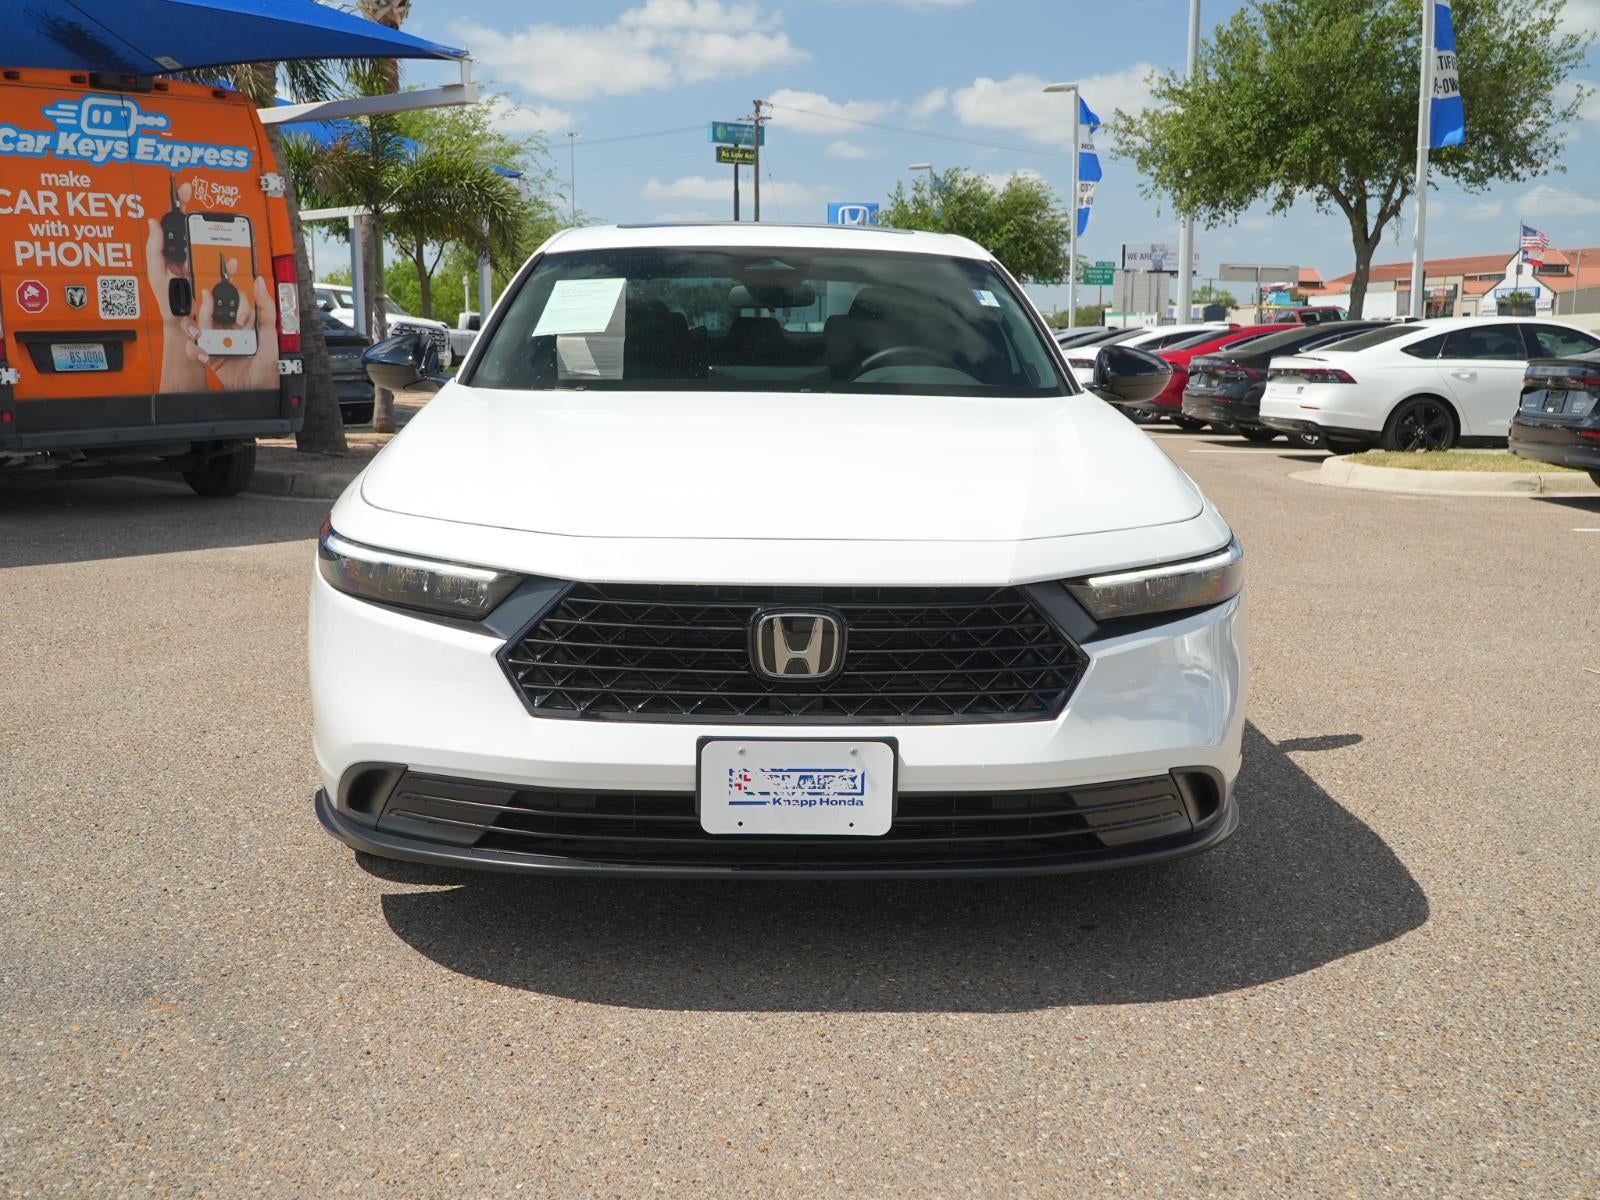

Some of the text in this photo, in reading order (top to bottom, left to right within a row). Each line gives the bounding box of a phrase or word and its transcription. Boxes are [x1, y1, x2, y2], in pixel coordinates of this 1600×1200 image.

[0, 127, 249, 168] Car Keys Express
[40, 170, 91, 188] make
[210, 182, 239, 197] Snap
[0, 188, 145, 219] CAR KEYS
[28, 219, 115, 241] with your
[14, 240, 134, 268] PHONE!
[1127, 253, 1139, 261] WE
[772, 797, 864, 808] Knapp Honda
